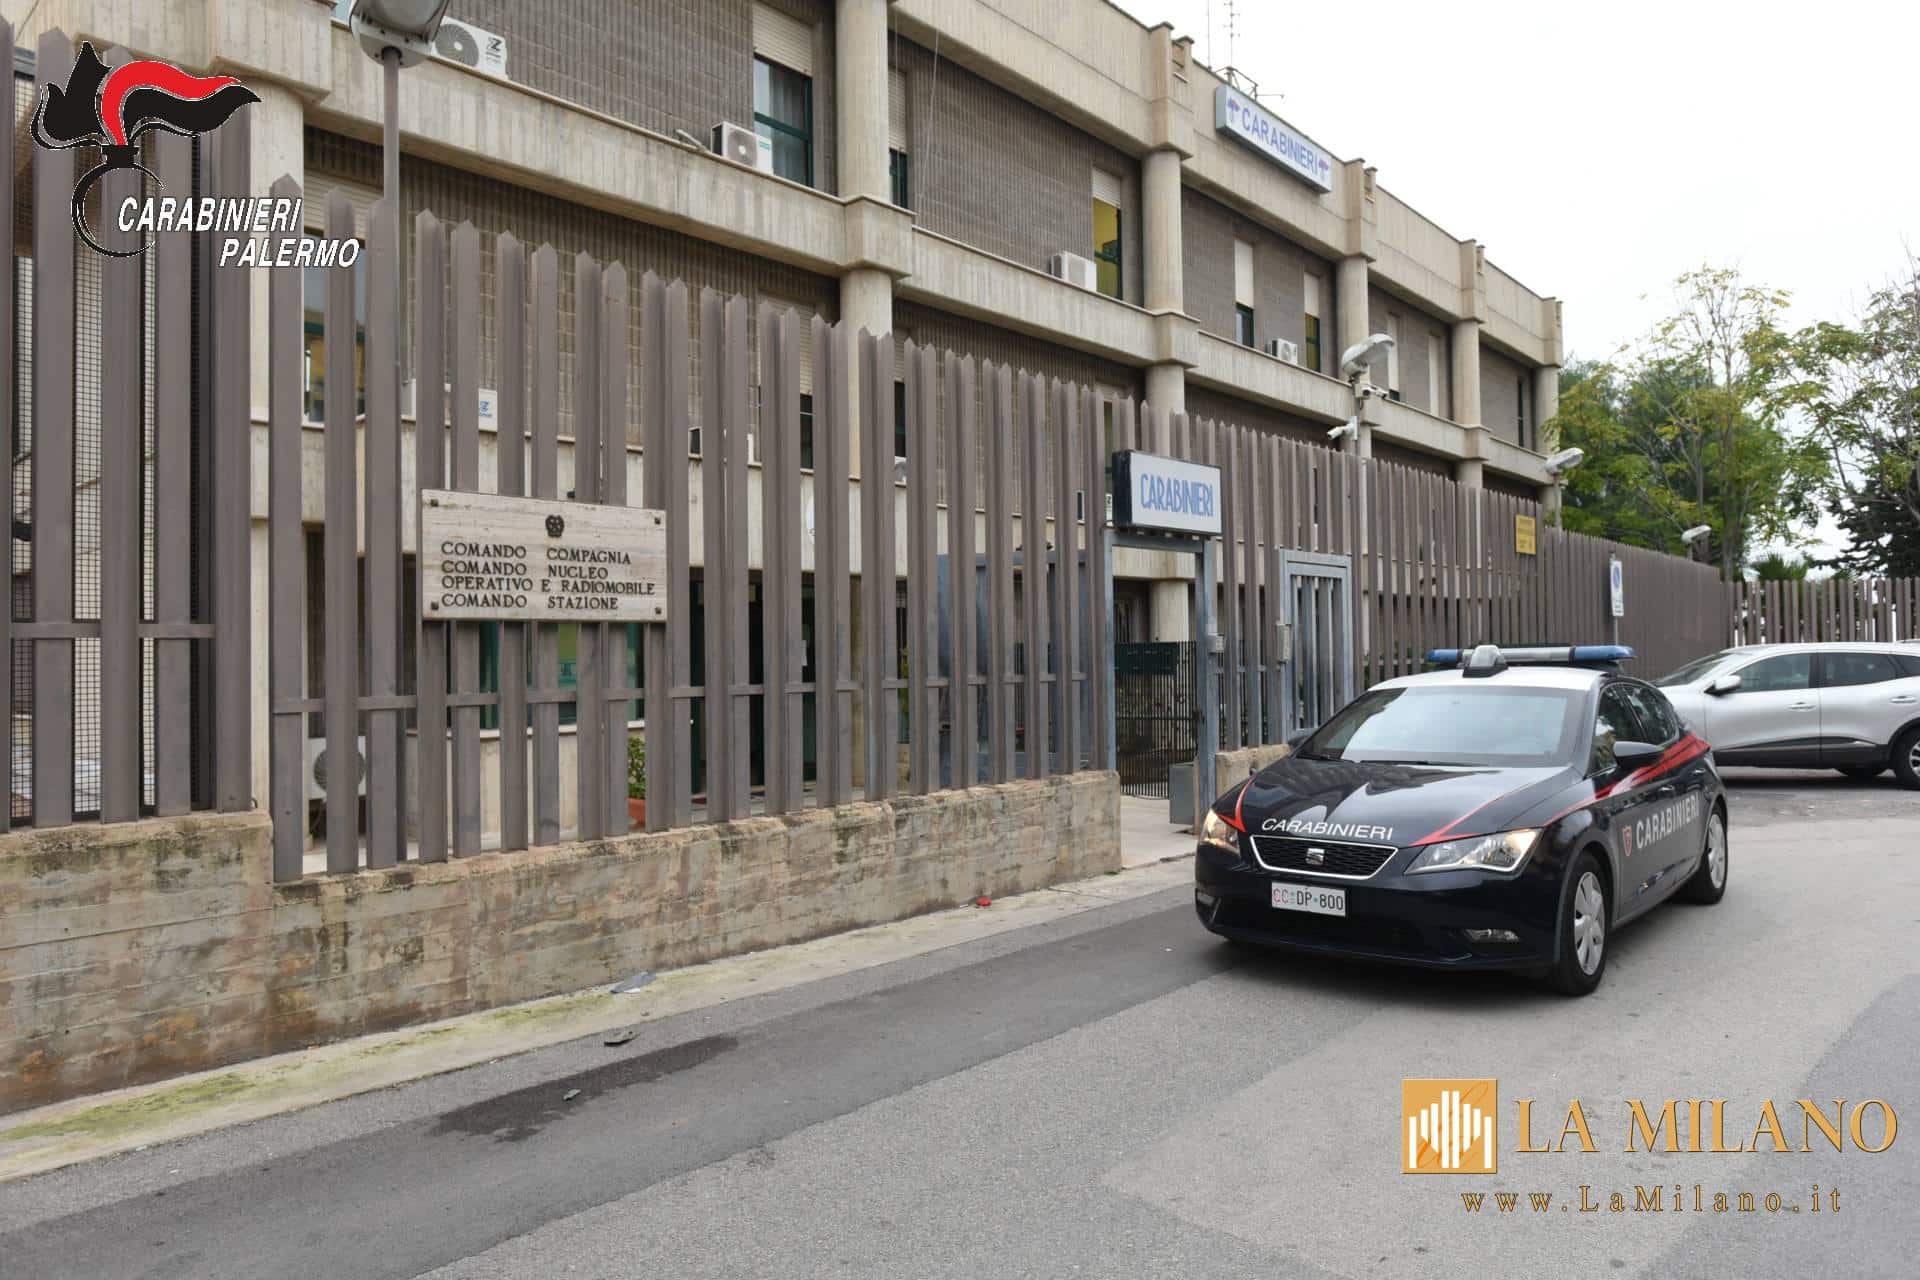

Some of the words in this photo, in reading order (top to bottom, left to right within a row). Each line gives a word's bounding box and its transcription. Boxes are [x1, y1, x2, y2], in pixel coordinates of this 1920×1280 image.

[1241, 107, 1318, 177] CARABINIERI
[1140, 473, 1214, 517] CARABINIERI
[441, 541, 527, 559] COMANDO
[546, 547, 631, 566] COMPAGNIA
[441, 560, 527, 576] COMANDO
[547, 566, 608, 579] NUCLEO
[441, 576, 533, 591] OPERATIVO
[541, 578, 551, 593] E
[561, 579, 655, 595] RADIOMOBILE
[441, 593, 527, 609] COMANDO
[547, 597, 618, 610] STAZIONE
[1261, 818, 1393, 840] CARABINIERI
[1636, 791, 1699, 849] CARABINIERI
